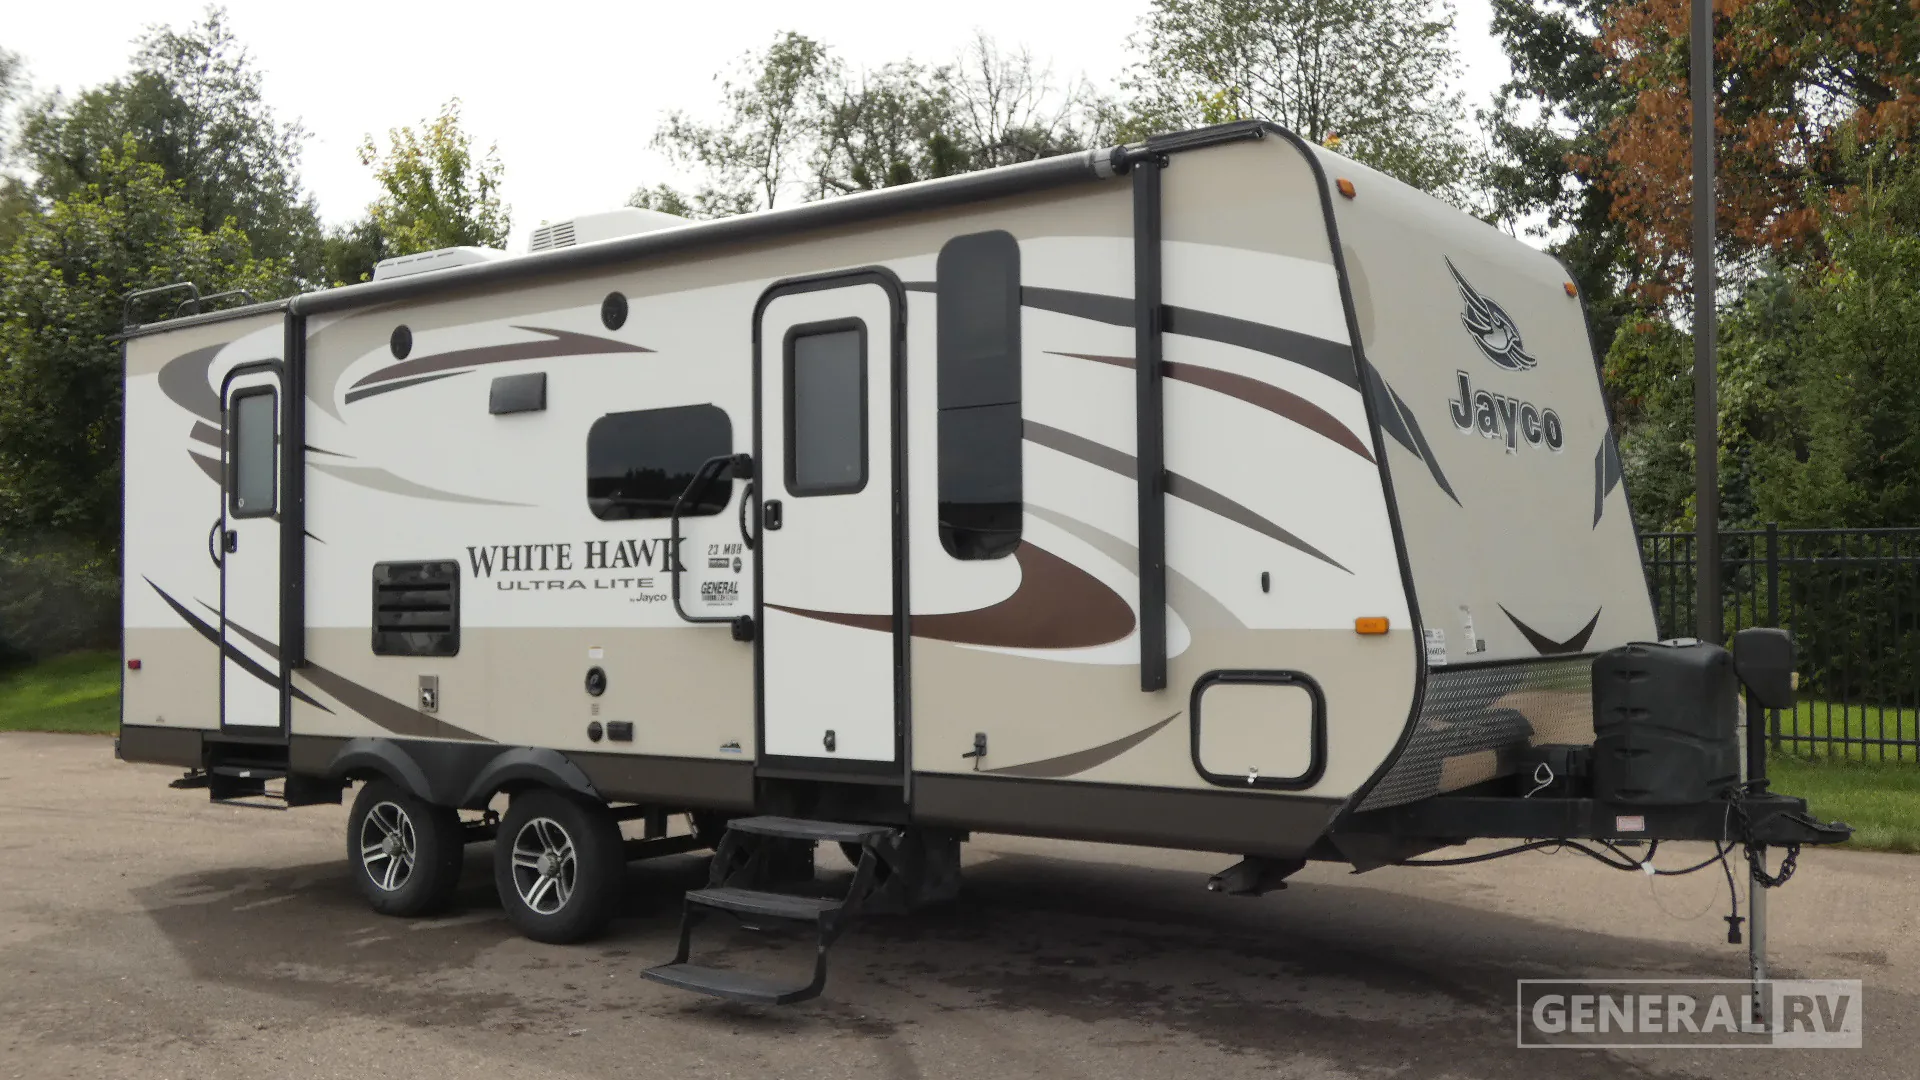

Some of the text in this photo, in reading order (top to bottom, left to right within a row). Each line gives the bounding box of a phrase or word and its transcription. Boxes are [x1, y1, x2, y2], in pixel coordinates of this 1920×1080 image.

[1448, 369, 1564, 455] Jayco
[466, 537, 688, 578] WHITE HAWK
[496, 577, 655, 591] ULTRA LITE
[700, 581, 739, 595] GENERAL
[636, 592, 668, 604] Jayco
